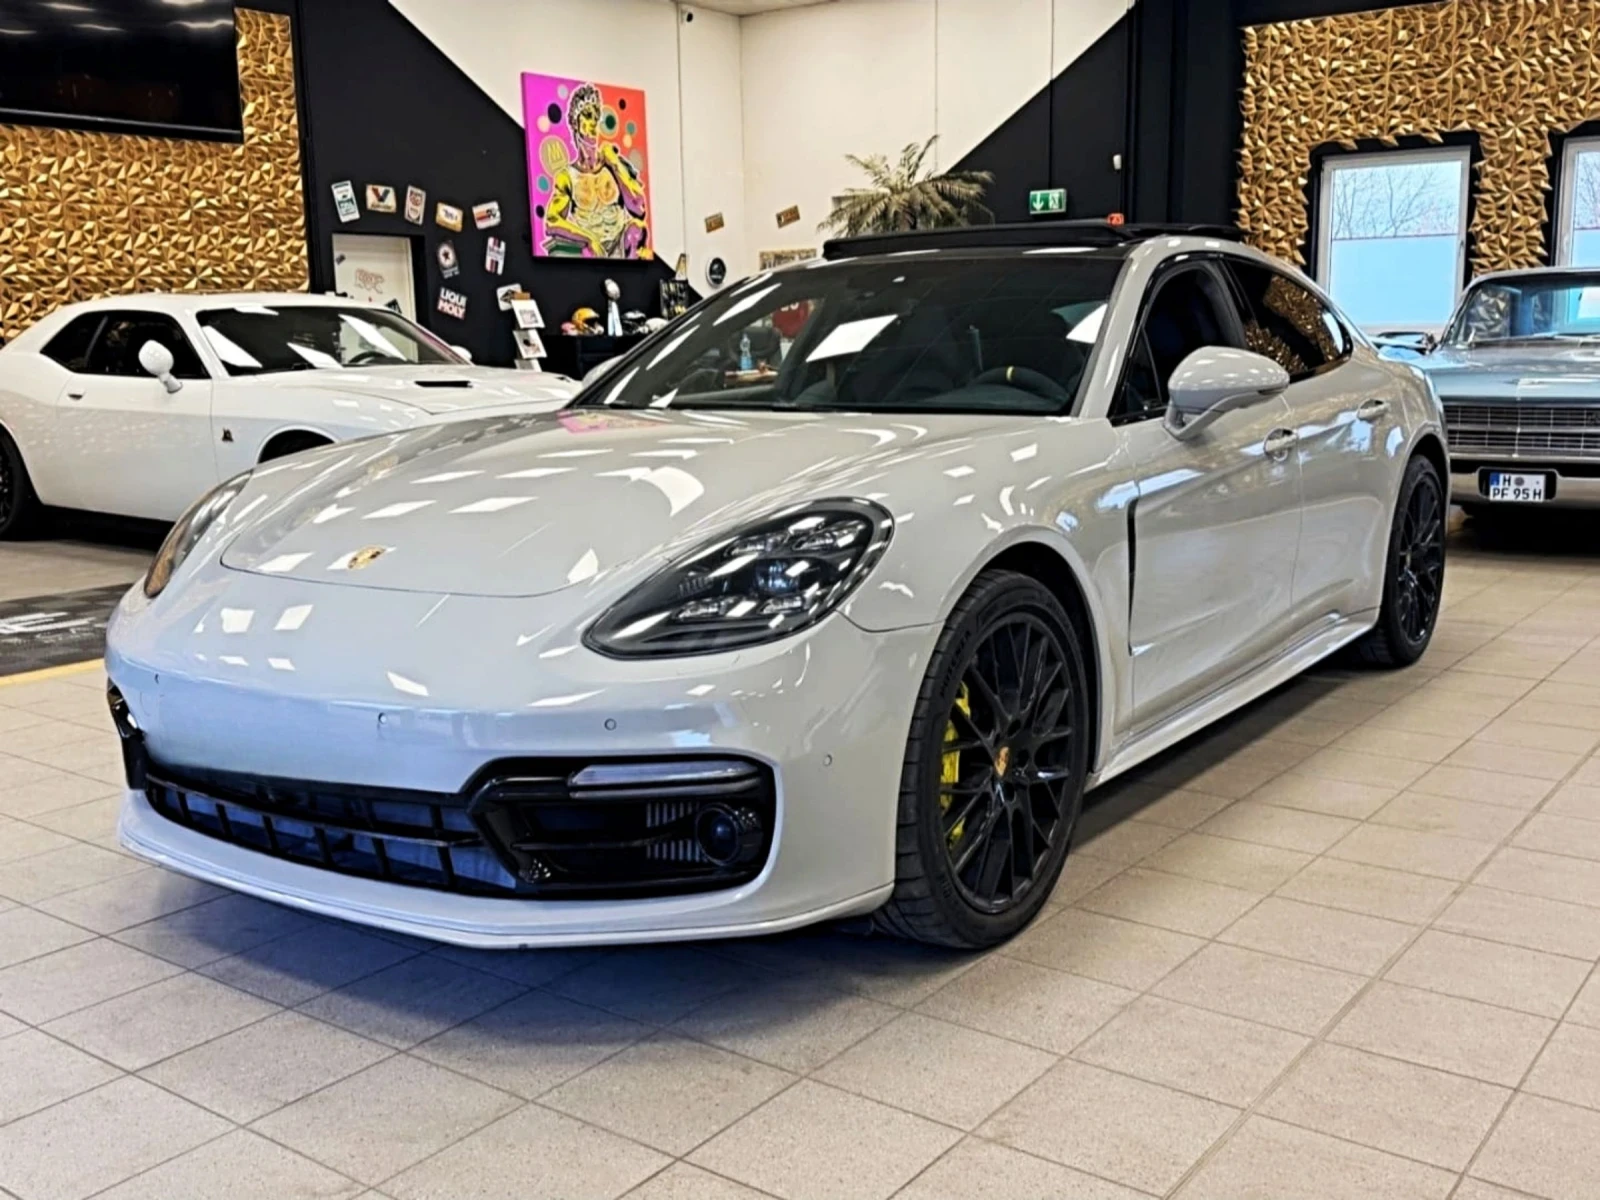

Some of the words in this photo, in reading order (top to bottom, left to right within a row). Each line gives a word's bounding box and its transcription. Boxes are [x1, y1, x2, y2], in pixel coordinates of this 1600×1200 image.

[437, 300, 466, 319] MOLY
[1502, 474, 1511, 486] H
[1492, 487, 1509, 499] PF
[1513, 488, 1530, 500] 95
[1533, 488, 1542, 500] H
